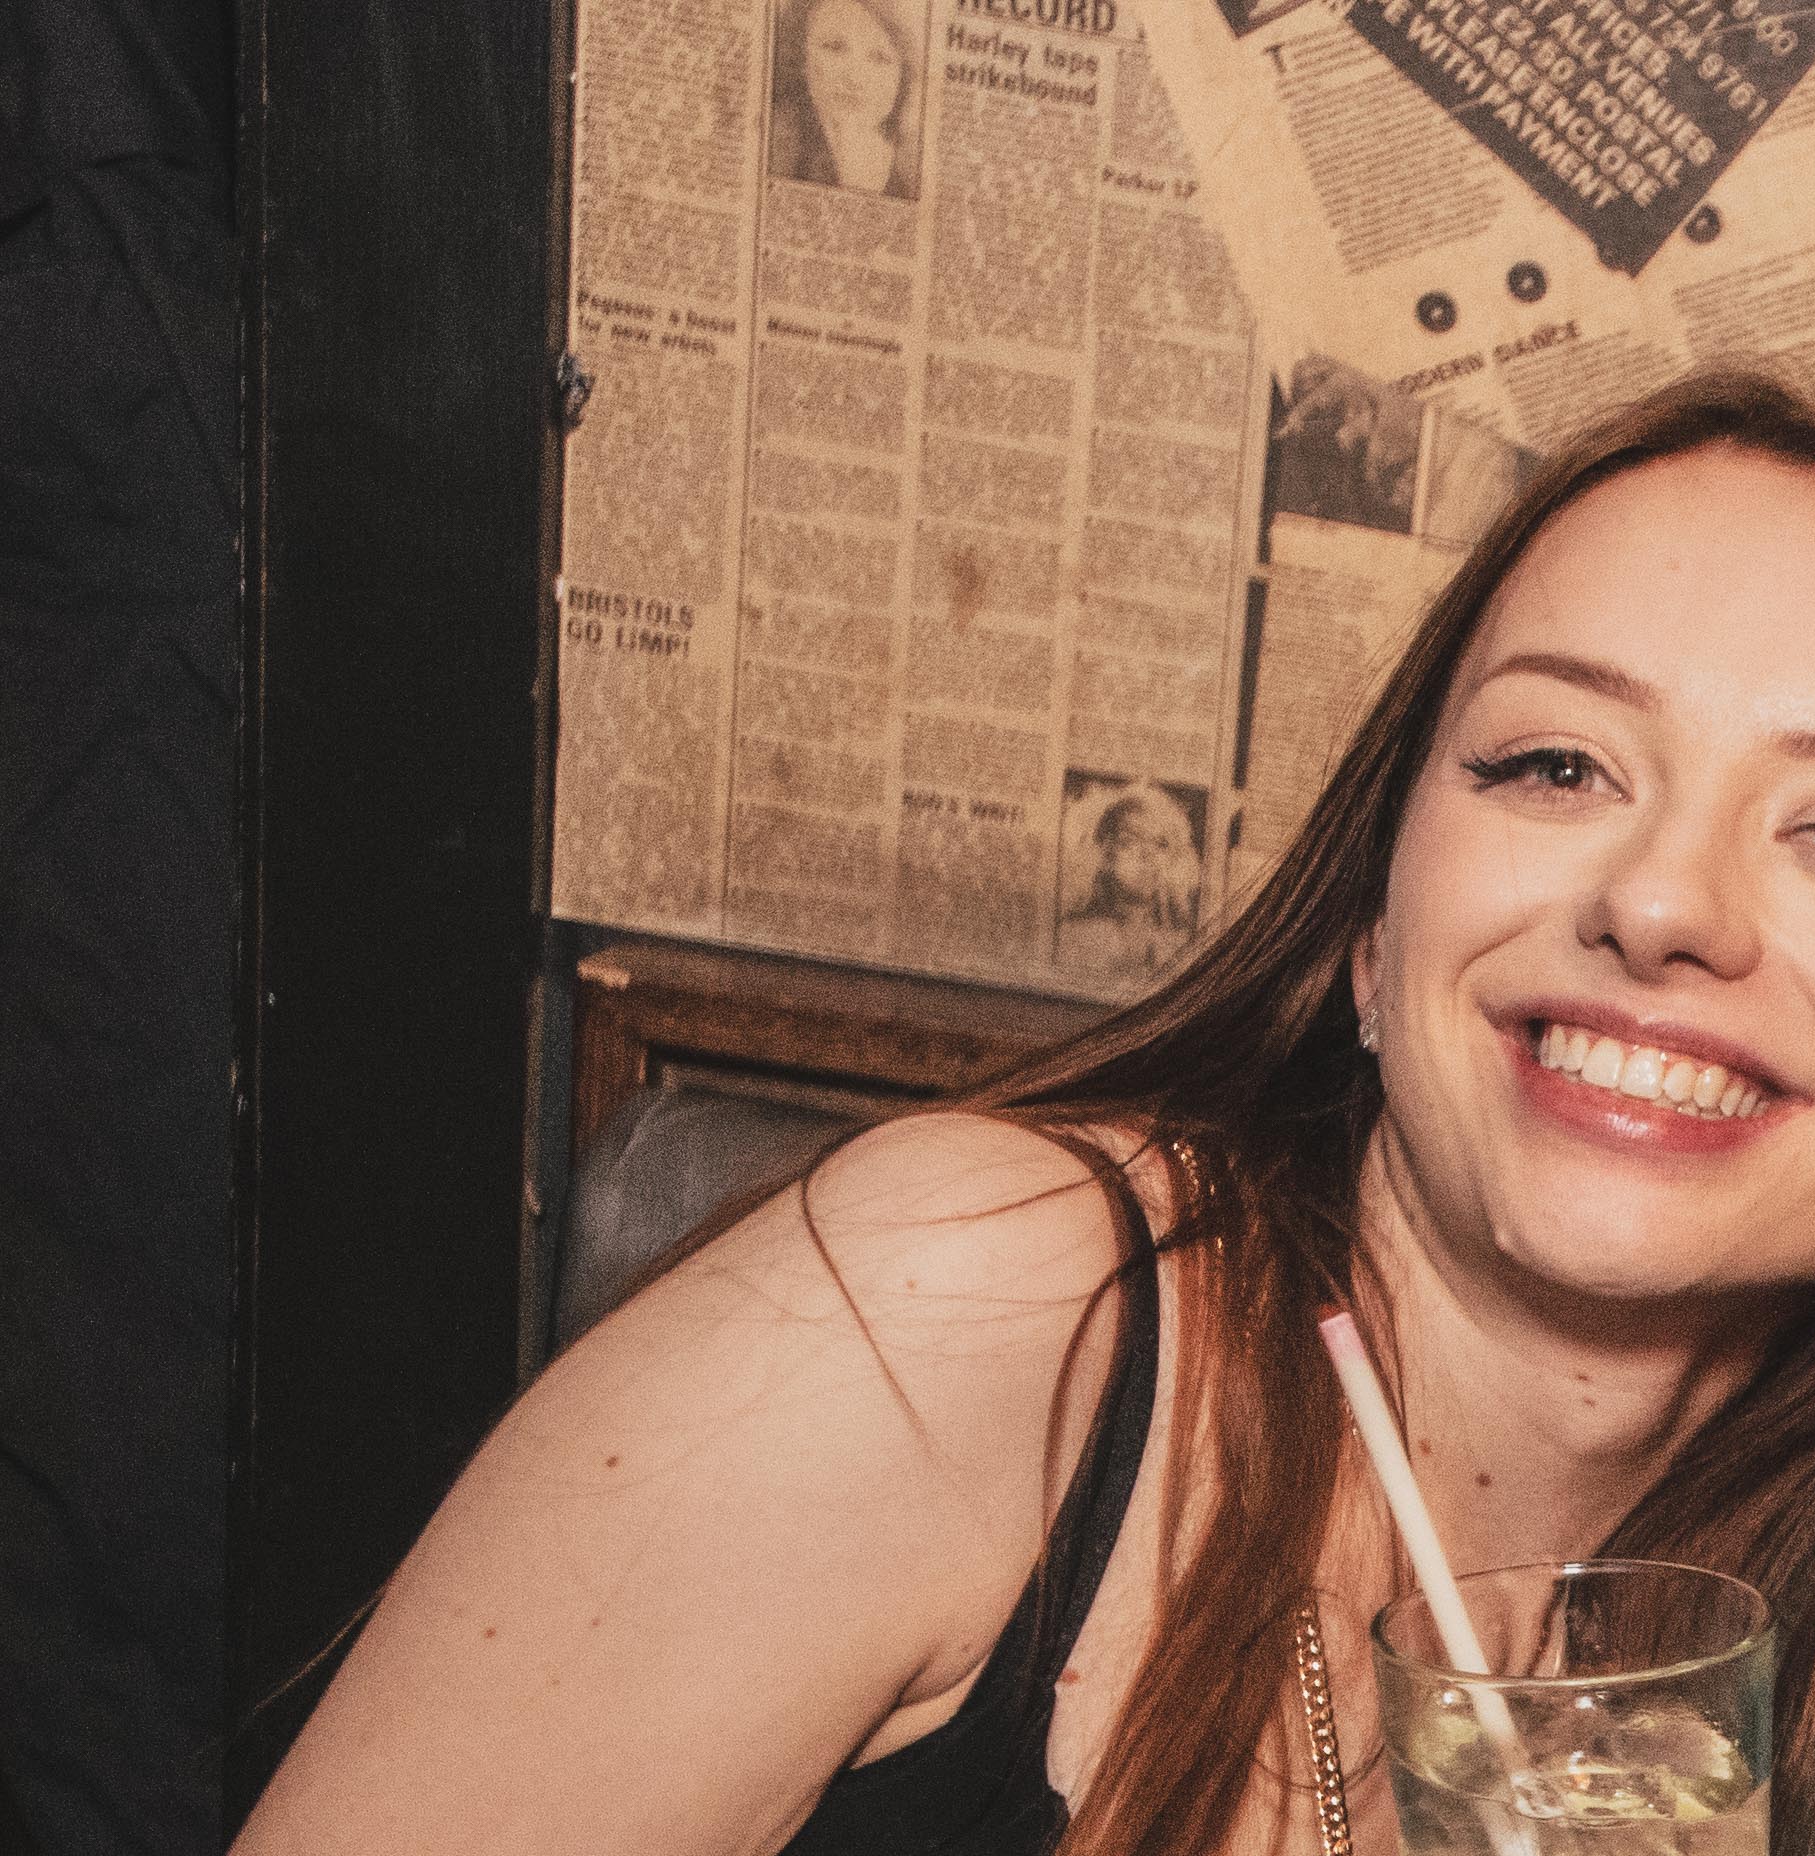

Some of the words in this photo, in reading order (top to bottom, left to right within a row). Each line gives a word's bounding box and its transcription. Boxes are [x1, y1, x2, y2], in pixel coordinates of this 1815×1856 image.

[1408, 14, 1488, 94] WITH
[1481, 82, 1621, 207] PAYMENT
[1530, 81, 1662, 207] ENCLOSE
[1550, 11, 1601, 70] ALL
[1606, 55, 1718, 167] VENUES
[1577, 80, 1686, 188] POSTAL
